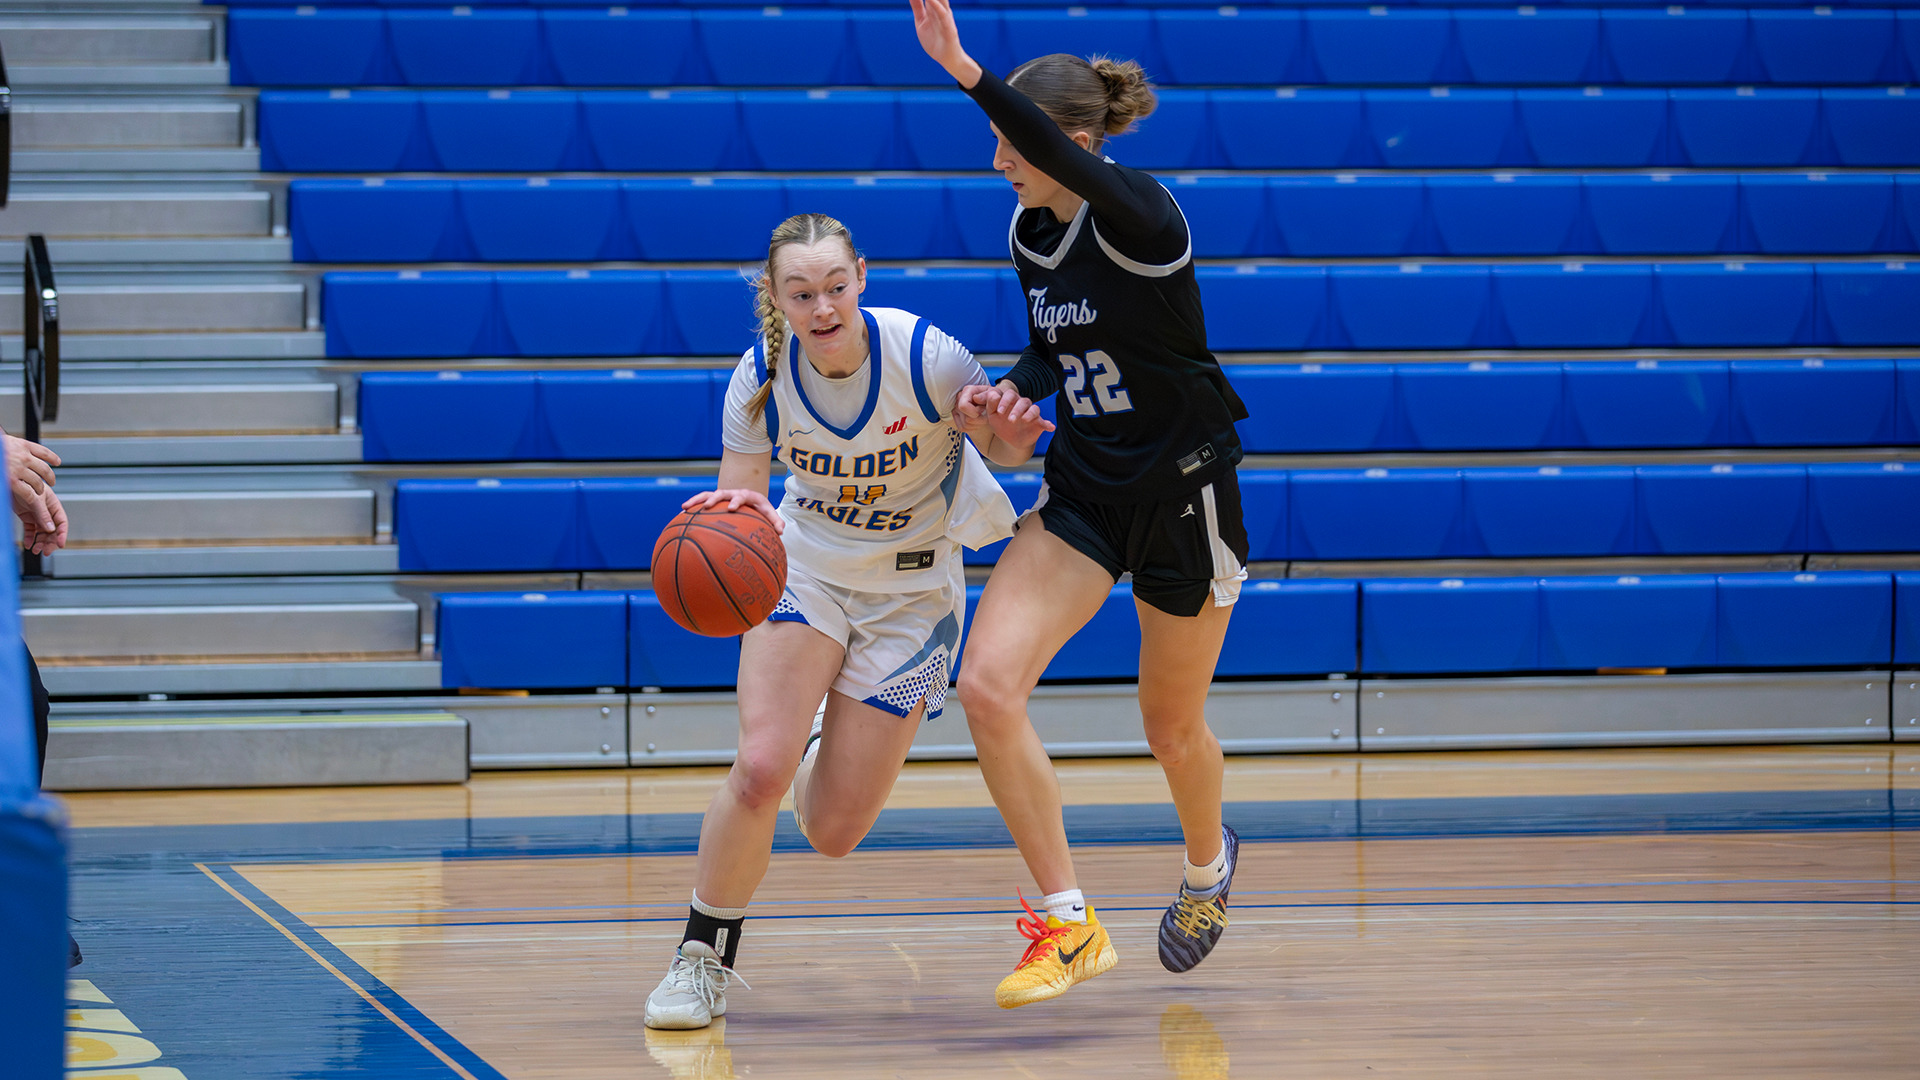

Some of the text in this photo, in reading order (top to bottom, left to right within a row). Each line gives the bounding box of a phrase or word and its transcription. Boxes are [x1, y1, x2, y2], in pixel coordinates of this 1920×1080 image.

[1029, 287, 1097, 344] Tigers
[1057, 349, 1135, 418] 22
[790, 434, 919, 478] GOLDEN
[1201, 449, 1212, 459] M
[922, 556, 931, 564] M
